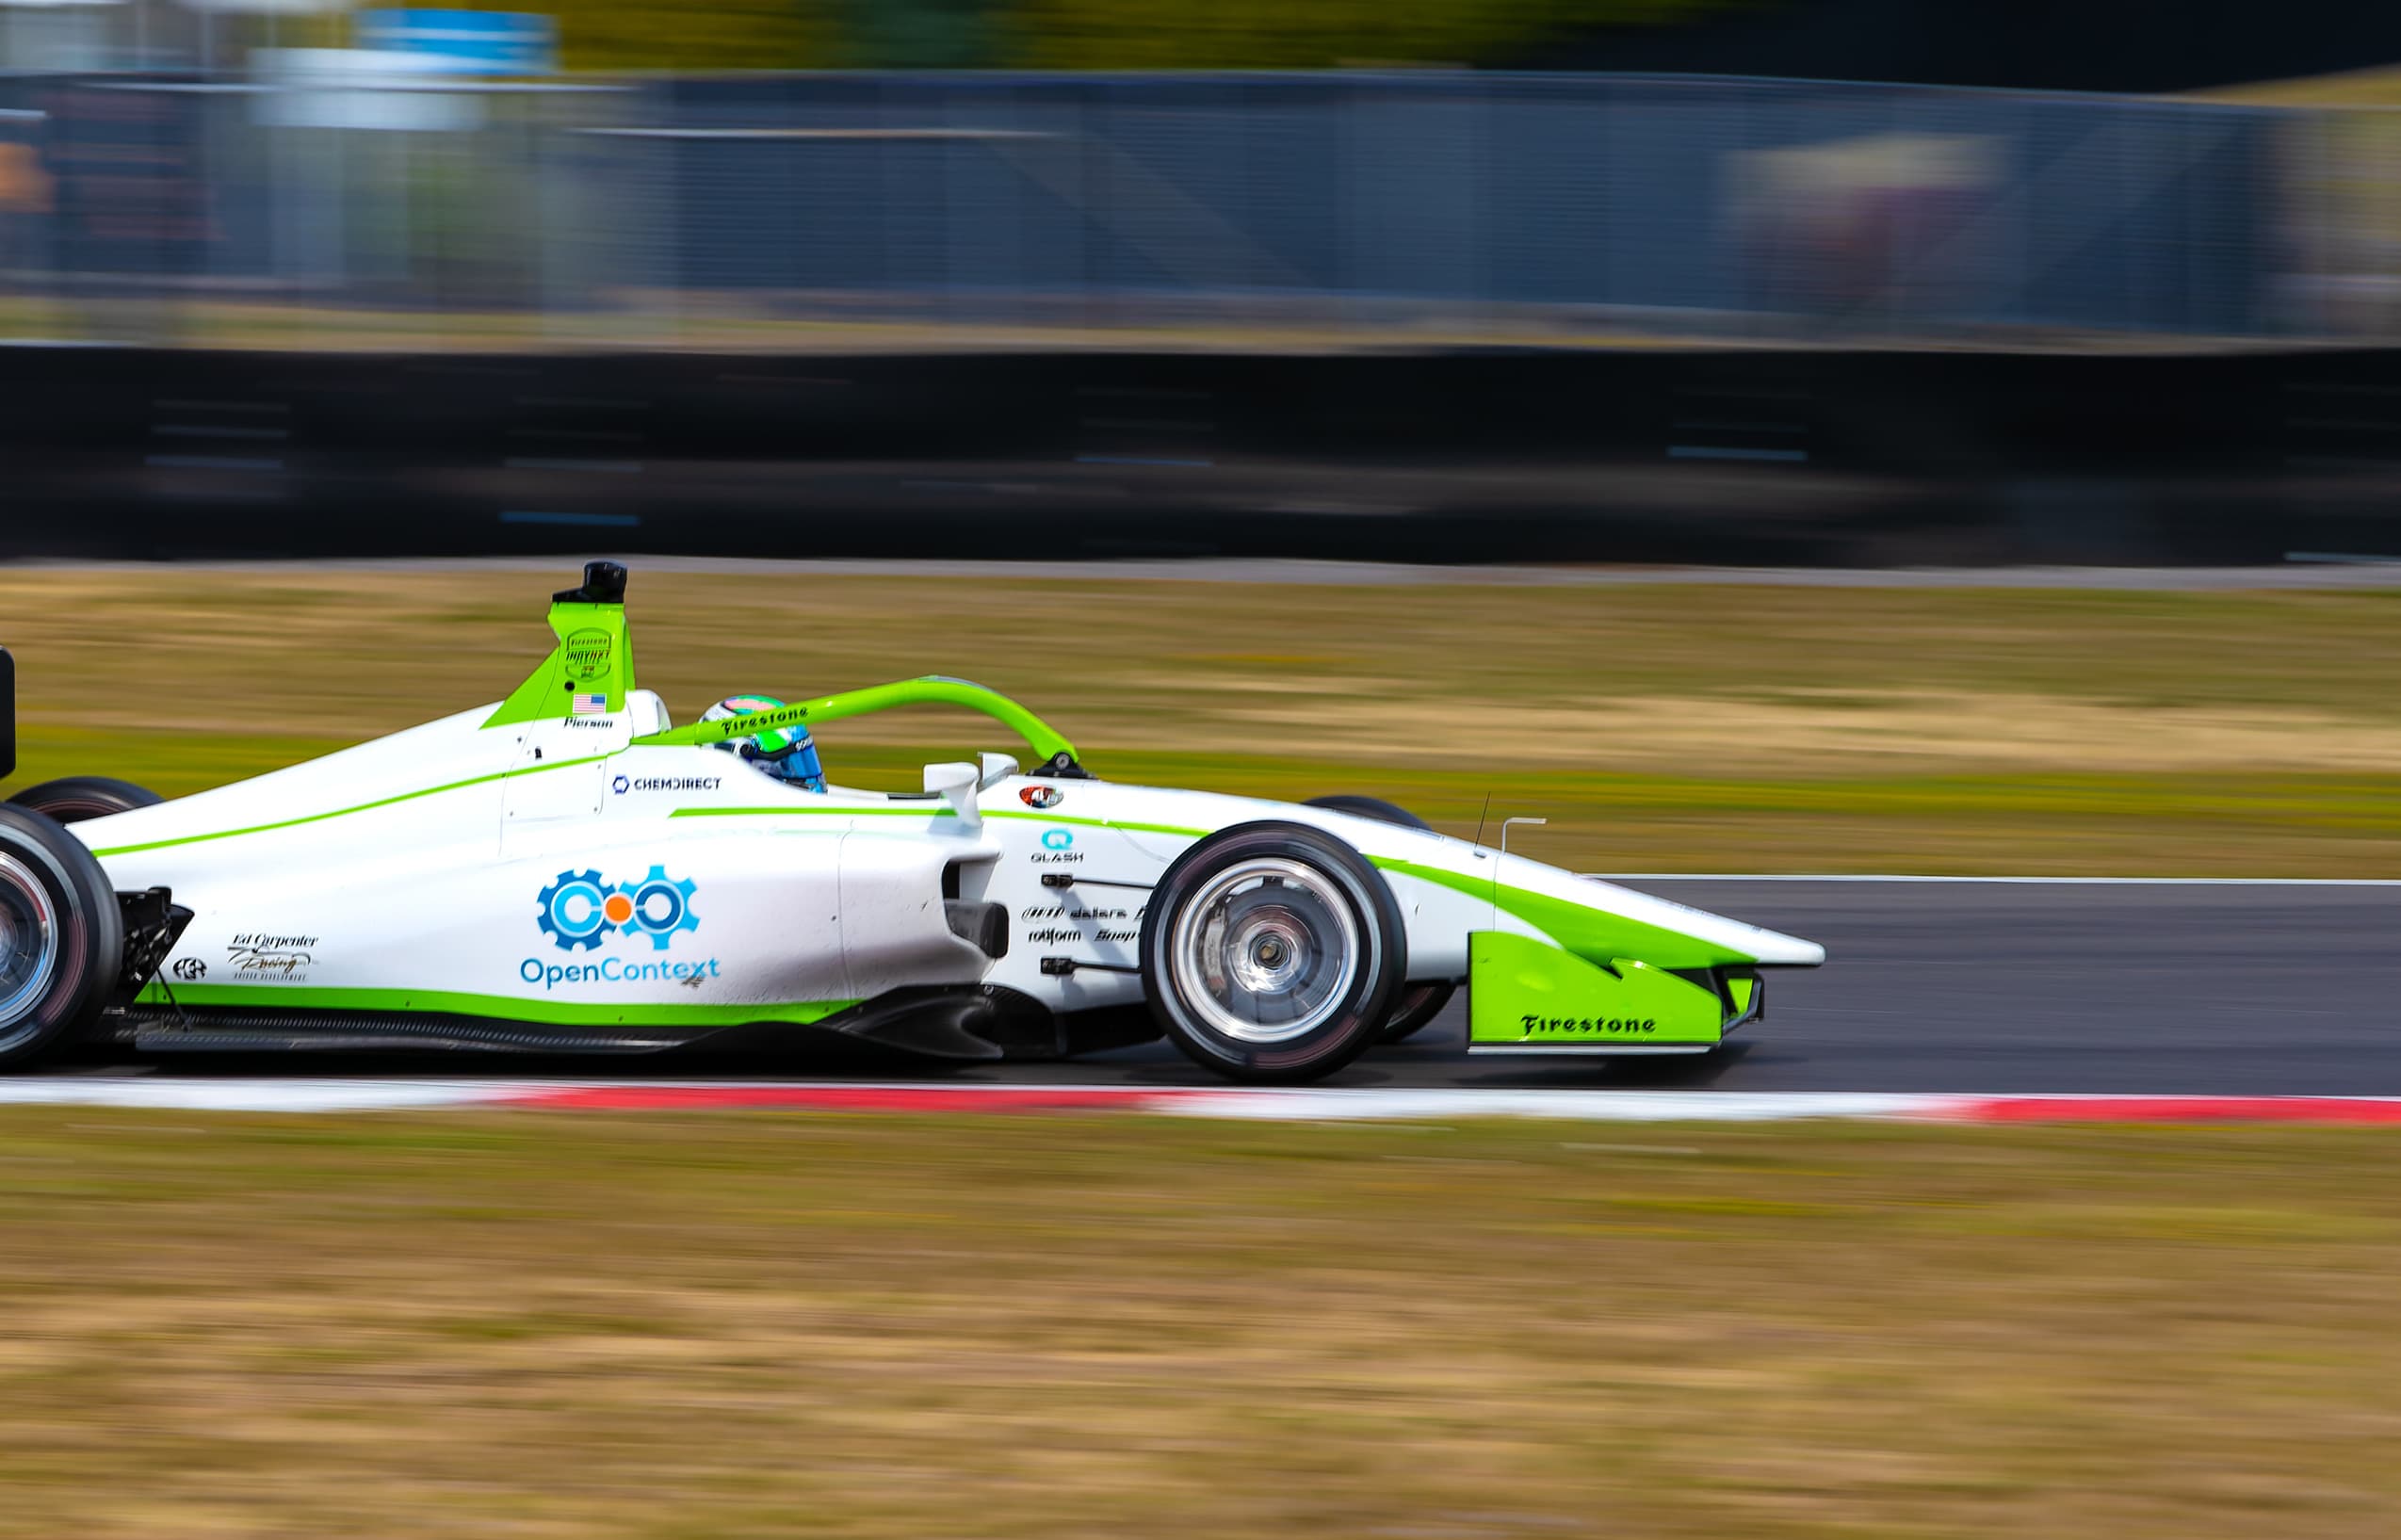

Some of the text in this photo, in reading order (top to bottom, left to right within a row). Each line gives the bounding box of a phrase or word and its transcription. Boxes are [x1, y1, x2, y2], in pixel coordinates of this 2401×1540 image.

[564, 716, 613, 729] Pierson
[721, 706, 809, 736] Firestone
[634, 776, 722, 791] CHEMDIRECT
[233, 933, 319, 949] Ed Carpenter
[520, 957, 721, 990] OpenContext
[1520, 1013, 1656, 1036] Firestone
